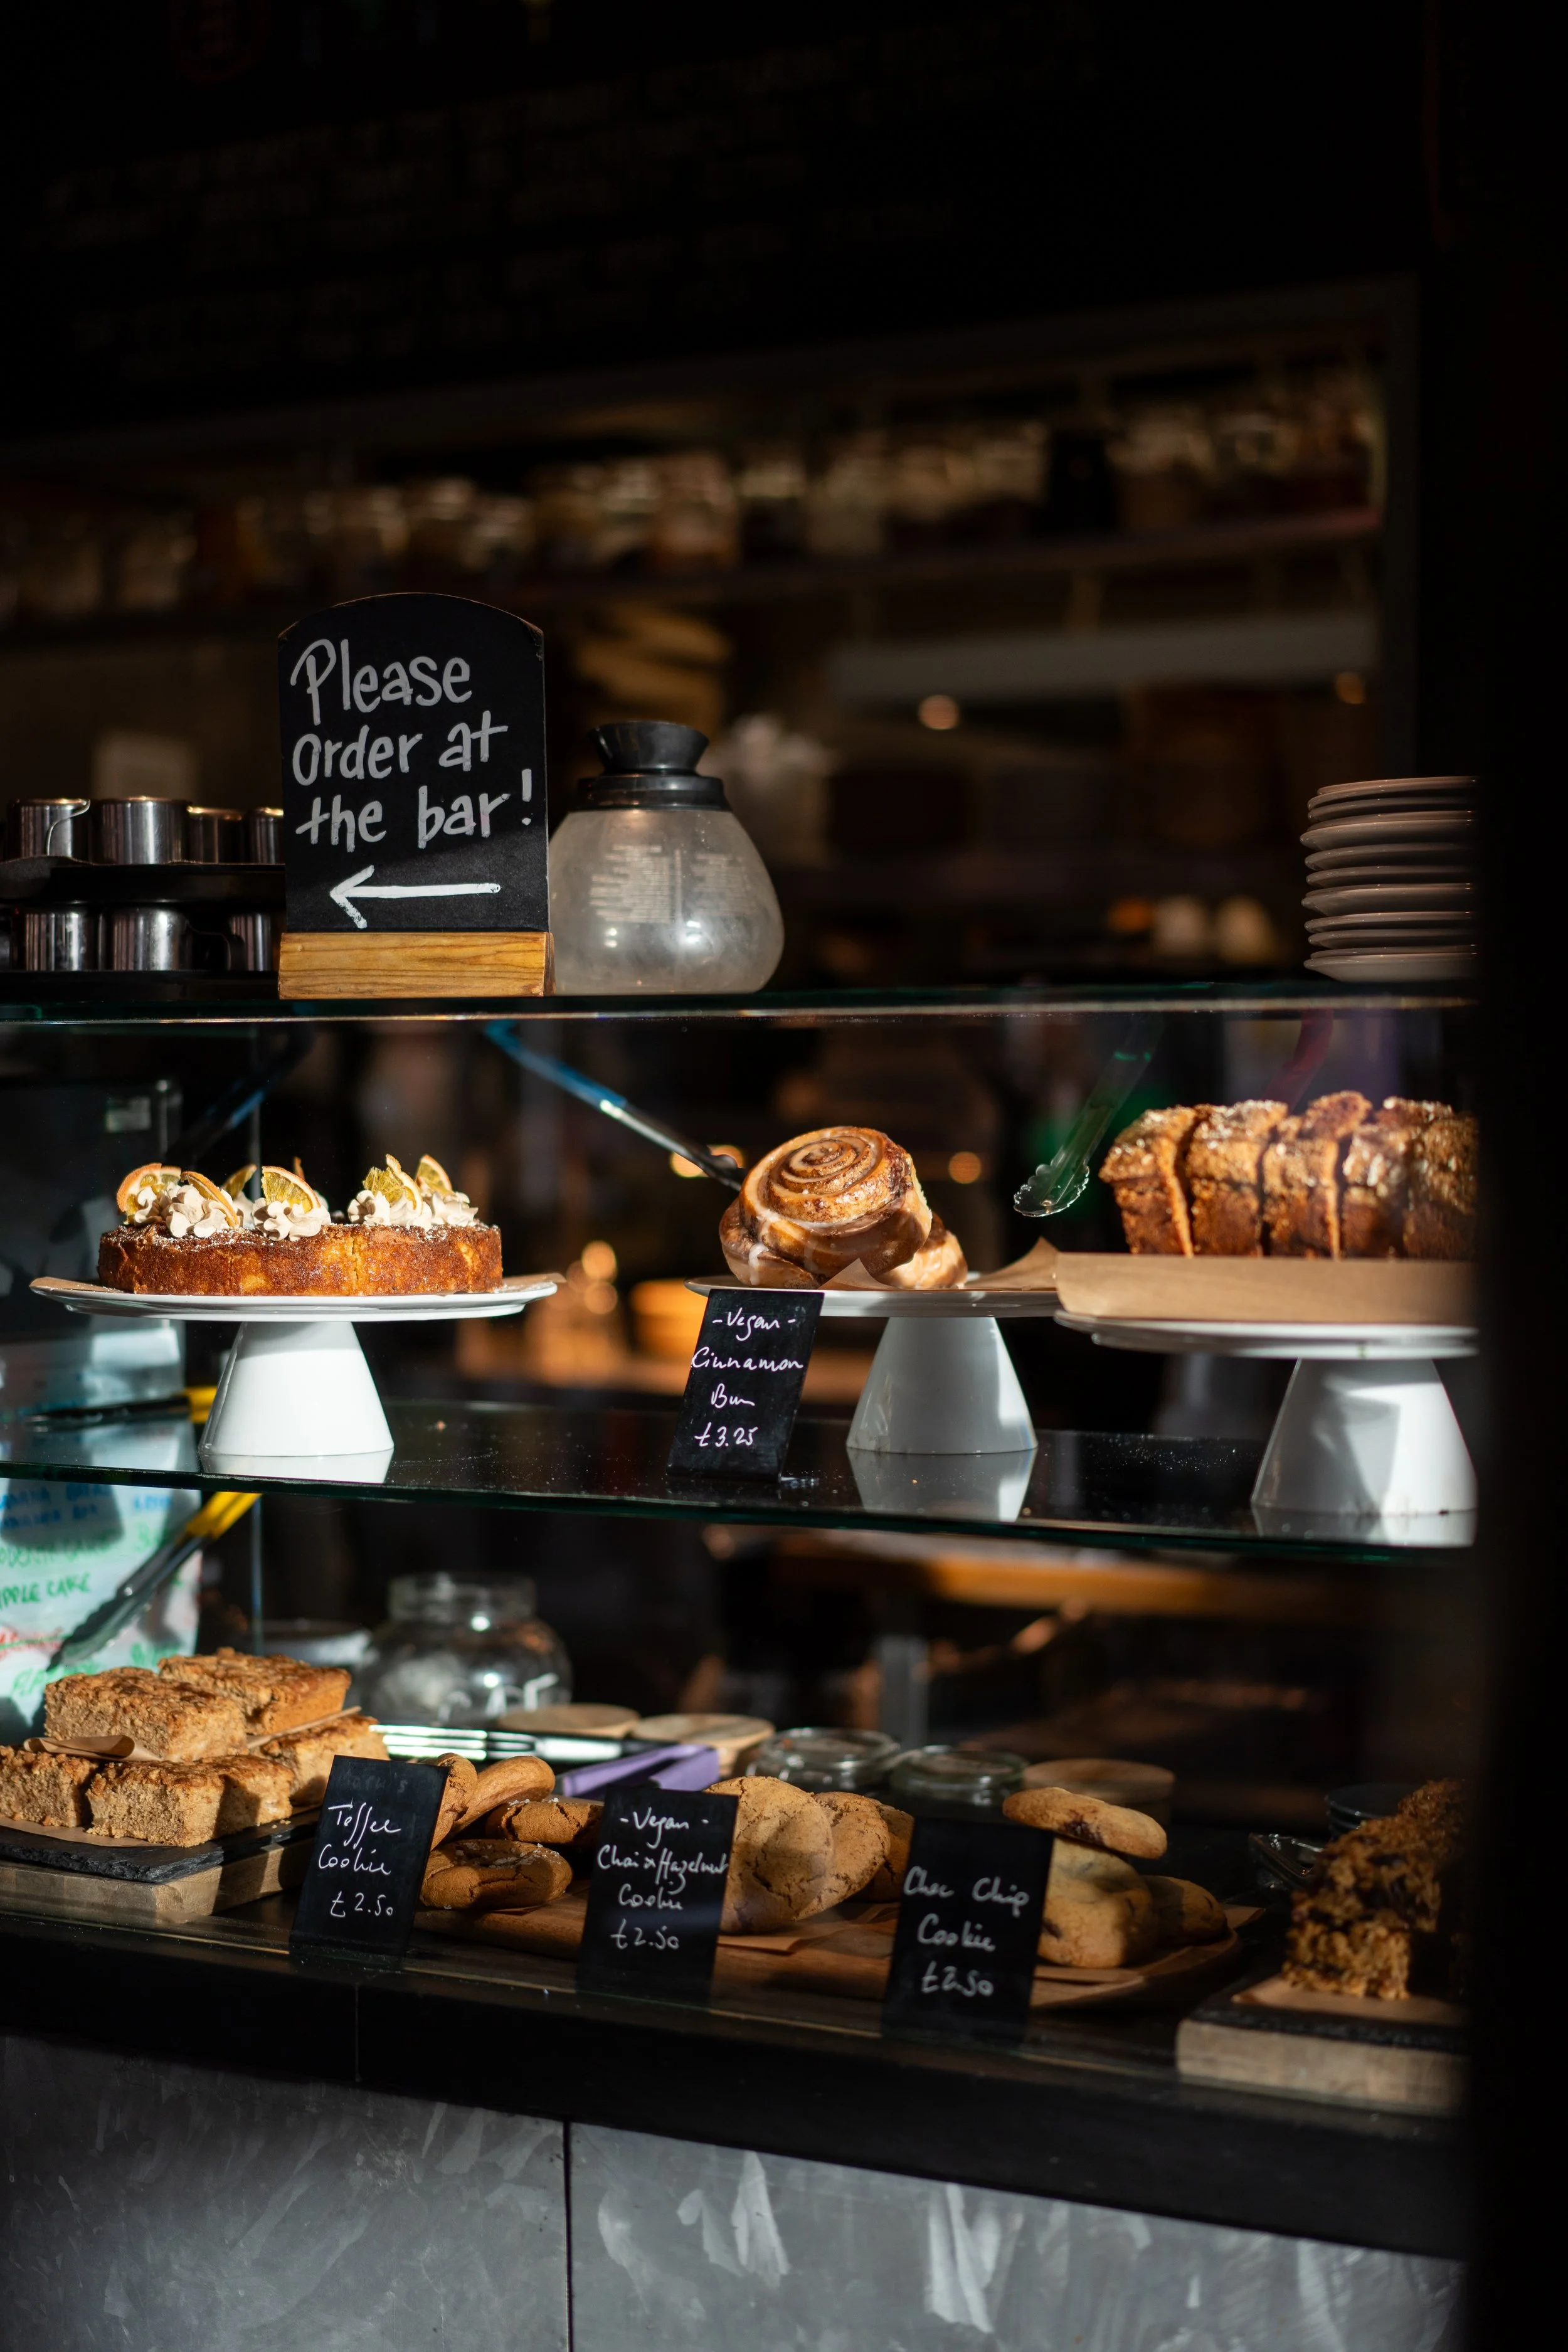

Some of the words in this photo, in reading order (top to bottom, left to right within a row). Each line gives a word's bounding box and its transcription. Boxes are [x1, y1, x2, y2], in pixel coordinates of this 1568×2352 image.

[290, 638, 472, 726] Please
[439, 711, 509, 771] at
[296, 794, 387, 852] the
[418, 768, 533, 849] bar!
[692, 1347, 803, 1372] Cinnamon
[711, 1383, 755, 1408] Bun
[694, 1422, 758, 1447] £3.25
[328, 1803, 401, 1849] Toffee
[319, 1844, 391, 1875] Cookie
[618, 1883, 683, 1910] Cookie
[973, 1876, 1030, 1917] Chip
[917, 1913, 996, 1952] Cookie
